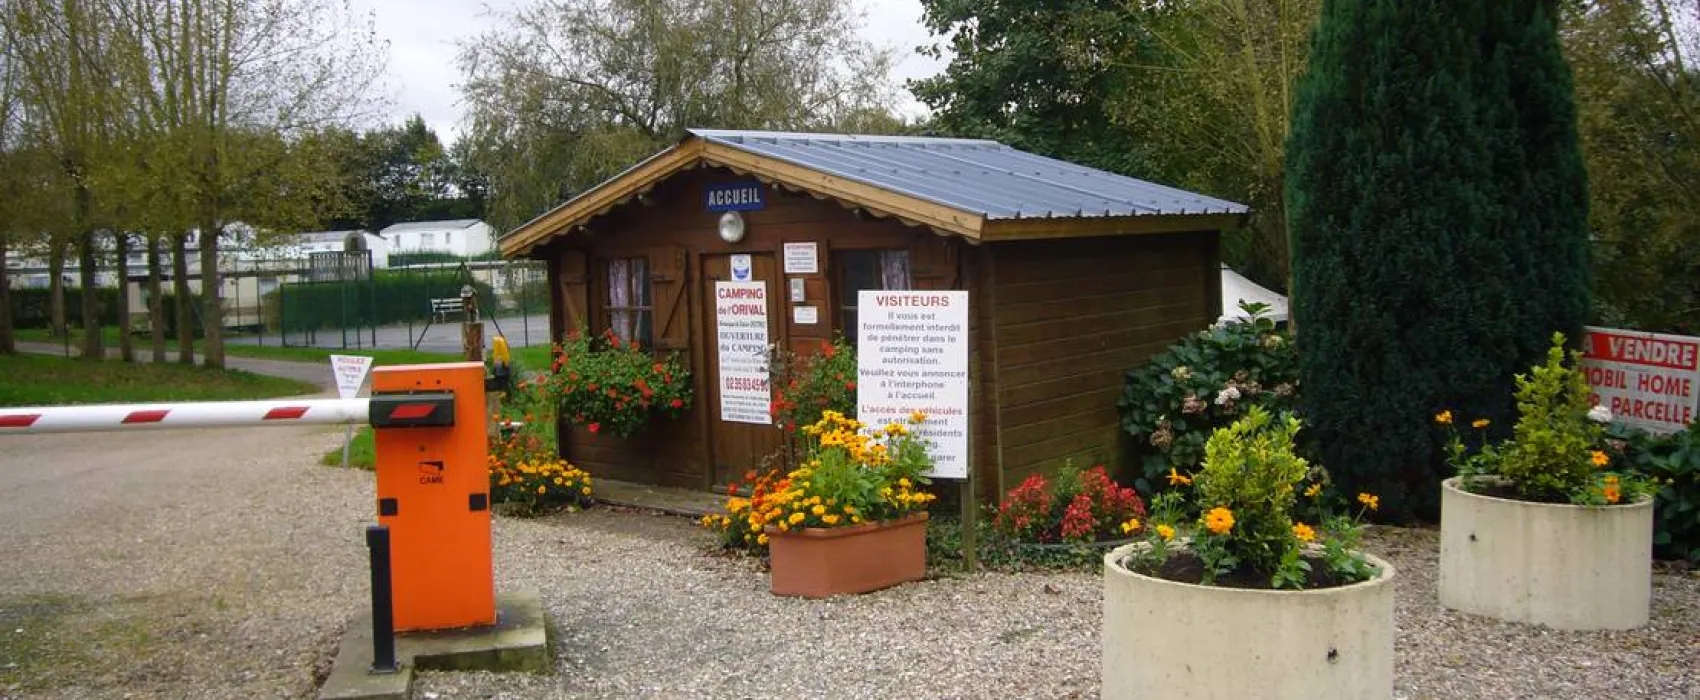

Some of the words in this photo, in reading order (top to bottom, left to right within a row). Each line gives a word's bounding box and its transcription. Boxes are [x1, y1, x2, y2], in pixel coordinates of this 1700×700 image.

[708, 187, 761, 206] ACCUEIL
[718, 288, 764, 299] CAMPING
[875, 294, 950, 307] VISITEURS
[887, 311, 894, 320] Il
[896, 312, 919, 320] vous
[921, 312, 936, 321] est
[863, 322, 925, 331] formellement
[926, 323, 961, 332] interdit
[866, 333, 879, 342] de
[880, 333, 921, 343] pénétrer
[922, 334, 946, 343] dans
[947, 334, 957, 343] le
[879, 346, 919, 355] camping
[1582, 335, 1594, 354] A
[1608, 336, 1694, 366] VENDRE
[881, 356, 942, 365] autorisation.
[860, 368, 895, 377] Veuillez
[897, 369, 920, 377] vous
[921, 370, 966, 378] annoncer
[888, 380, 945, 390] l'interphone
[1637, 372, 1692, 397] HOME
[861, 405, 896, 414] L'accès
[1611, 395, 1692, 425] PARCELLE
[919, 429, 963, 437] résidents
